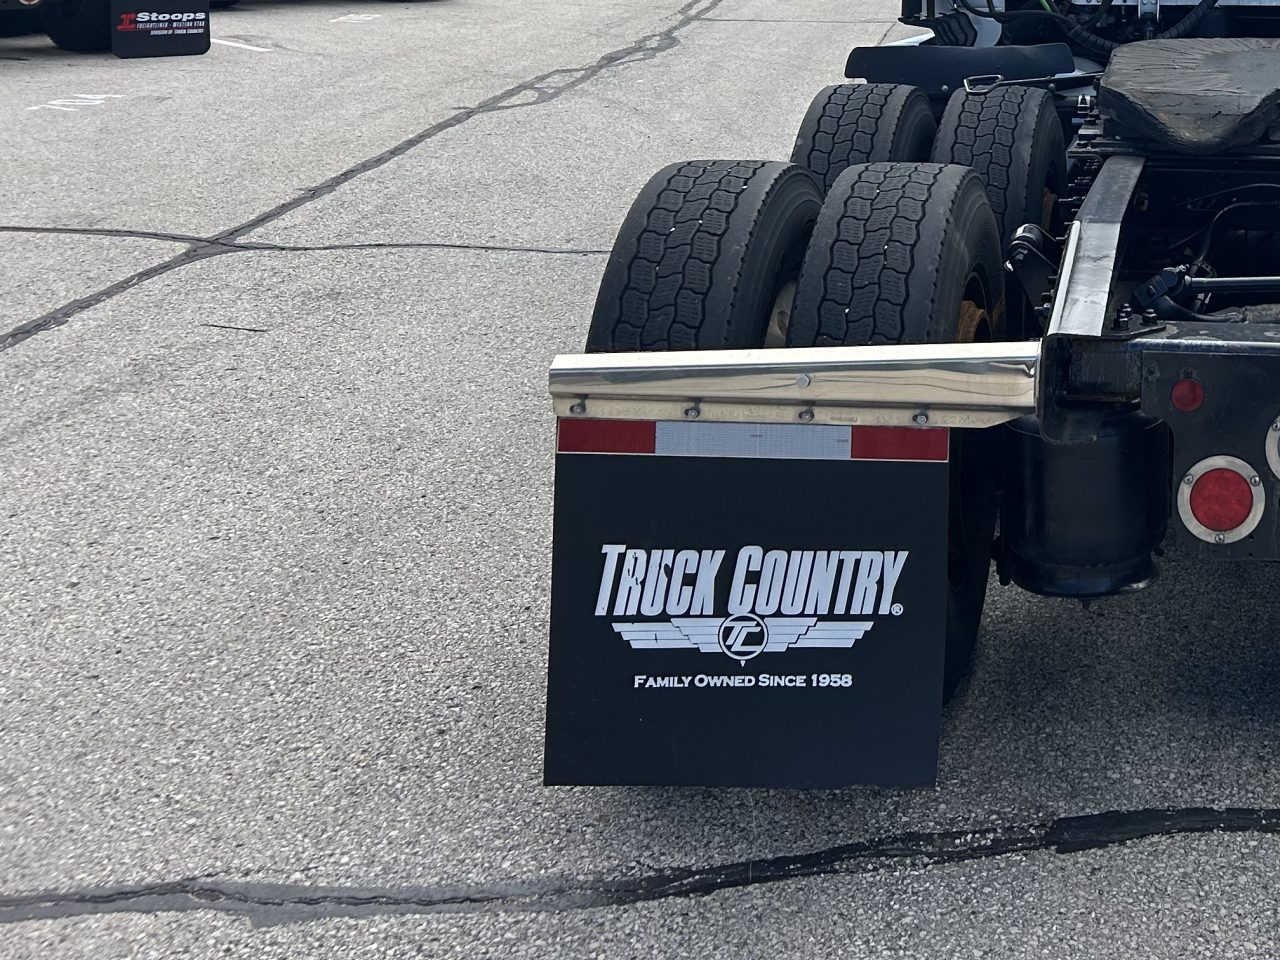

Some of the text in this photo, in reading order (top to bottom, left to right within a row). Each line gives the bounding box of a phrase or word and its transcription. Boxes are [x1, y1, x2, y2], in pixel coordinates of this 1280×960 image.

[136, 12, 206, 22] Stoops
[595, 544, 909, 617] TRUCK COUNTRY
[633, 673, 853, 688] FAMILY OWNED SINCE 1958
